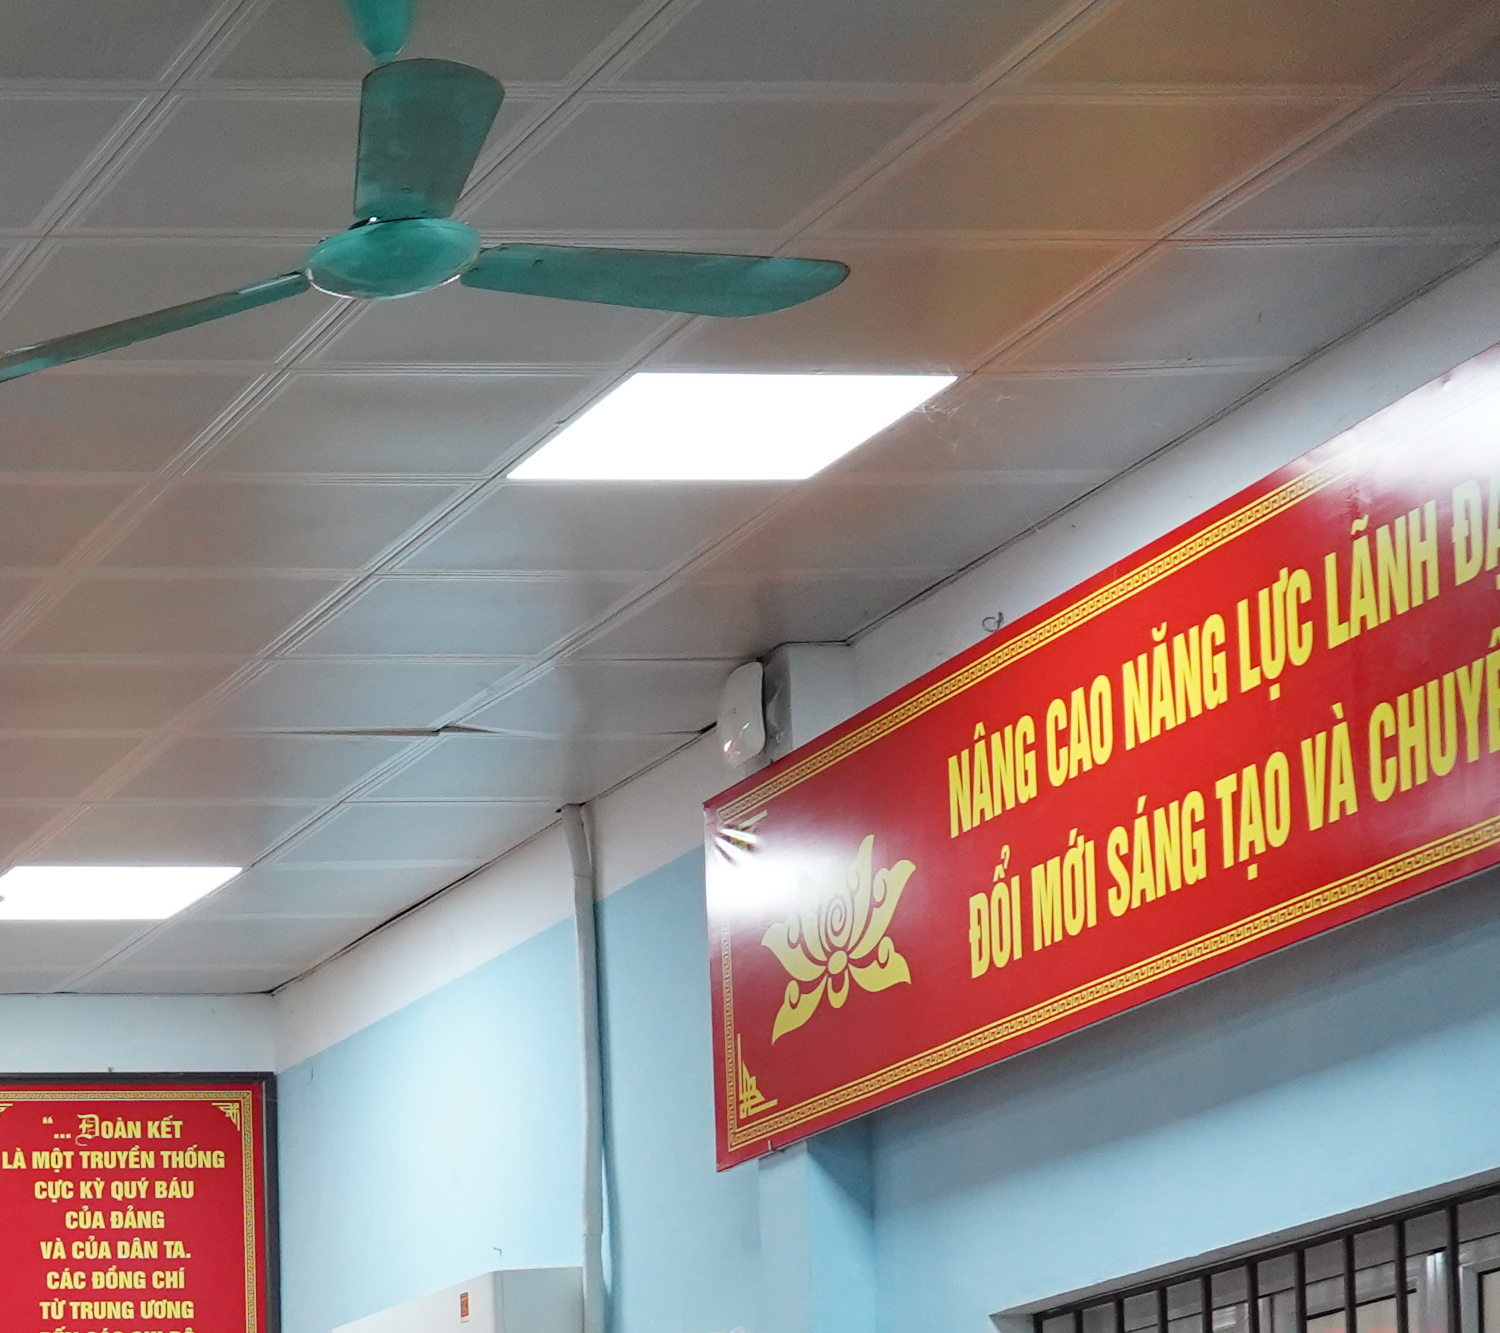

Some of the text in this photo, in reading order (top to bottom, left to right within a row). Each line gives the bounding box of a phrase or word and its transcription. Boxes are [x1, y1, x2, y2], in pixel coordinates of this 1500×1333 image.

[947, 712, 1038, 838] NÂNG
[1045, 675, 1113, 787] CAO
[1122, 613, 1227, 750] NĂNG
[1237, 567, 1313, 700] LỰC
[1325, 499, 1440, 650] LÃNH
[968, 843, 1022, 979] ĐỔI
[1033, 838, 1098, 952] MỚI
[1107, 790, 1206, 919] SÁNG
[1215, 750, 1292, 883] TẠO
[1300, 701, 1359, 833] VÀ
[75, 1113, 183, 1146] ĐOÀN KẾT
[2, 1146, 225, 1172] LÀ MỘT TRUYỀN THỐNG
[35, 1177, 194, 1203] CỰC KỲ QUÝ BÁU
[66, 1207, 164, 1229] CỦA ĐẢNG
[40, 1237, 191, 1259] VÀ CỦA DÂN TA.
[47, 1267, 184, 1289] CÁC ĐỒNG CHÍ
[39, 1298, 194, 1319] TỪ TRUNG ƯƠNG
